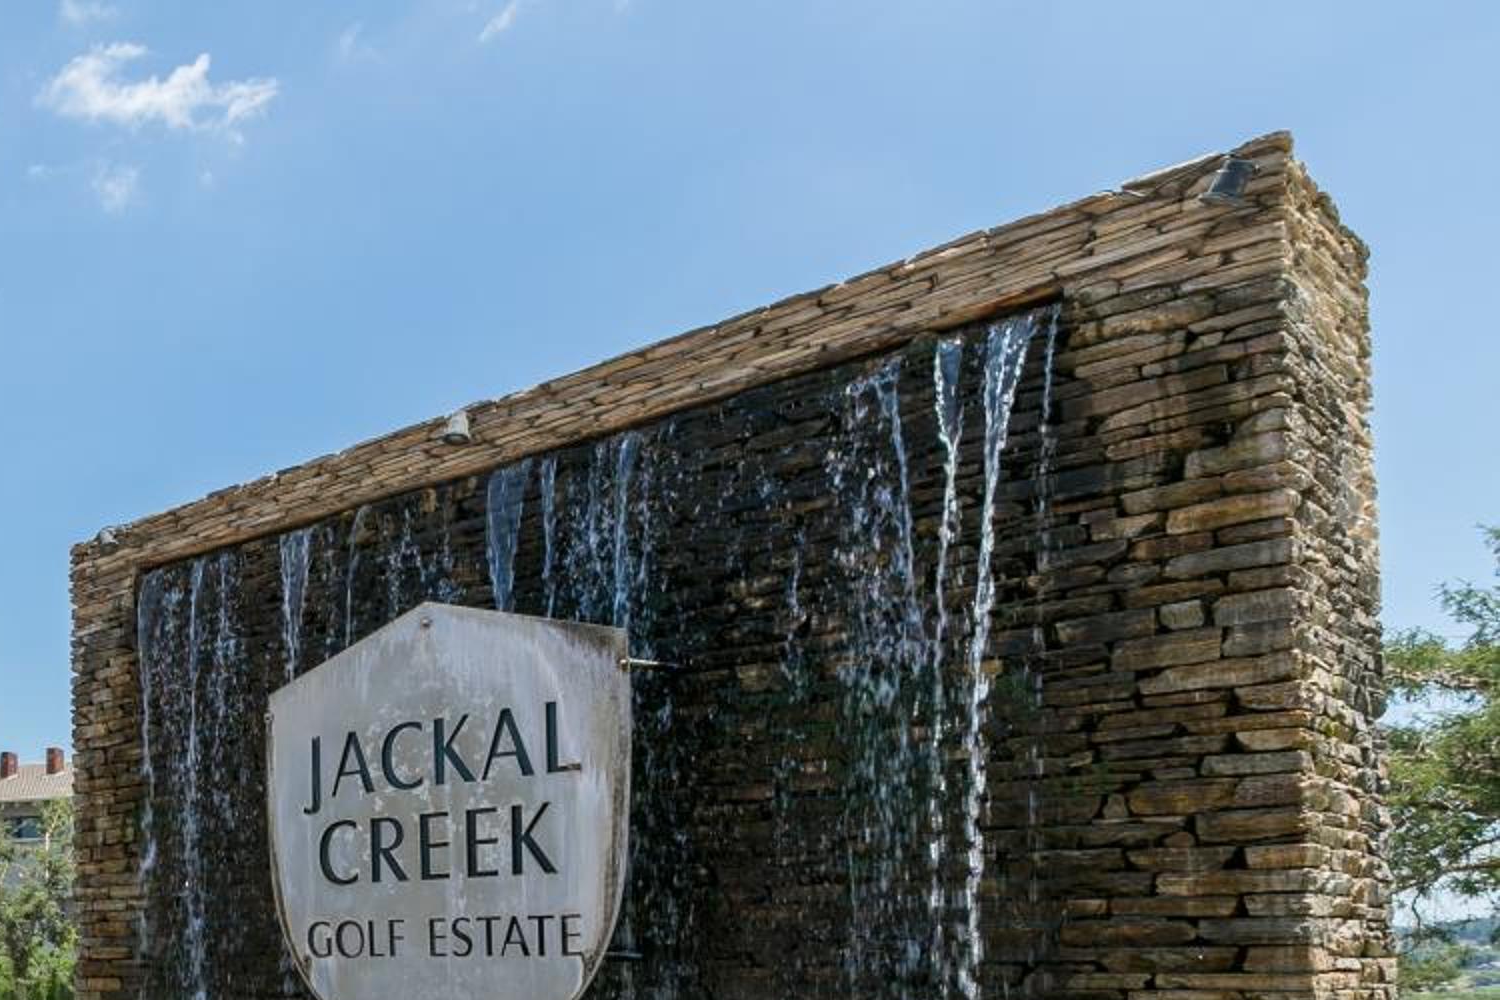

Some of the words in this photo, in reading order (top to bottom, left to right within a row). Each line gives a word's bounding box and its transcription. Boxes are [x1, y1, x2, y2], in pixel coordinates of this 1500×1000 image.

[303, 701, 581, 815] JACKAL
[319, 801, 557, 885] CREEK
[307, 919, 404, 958] GOLF
[428, 914, 583, 957] ESTATE
